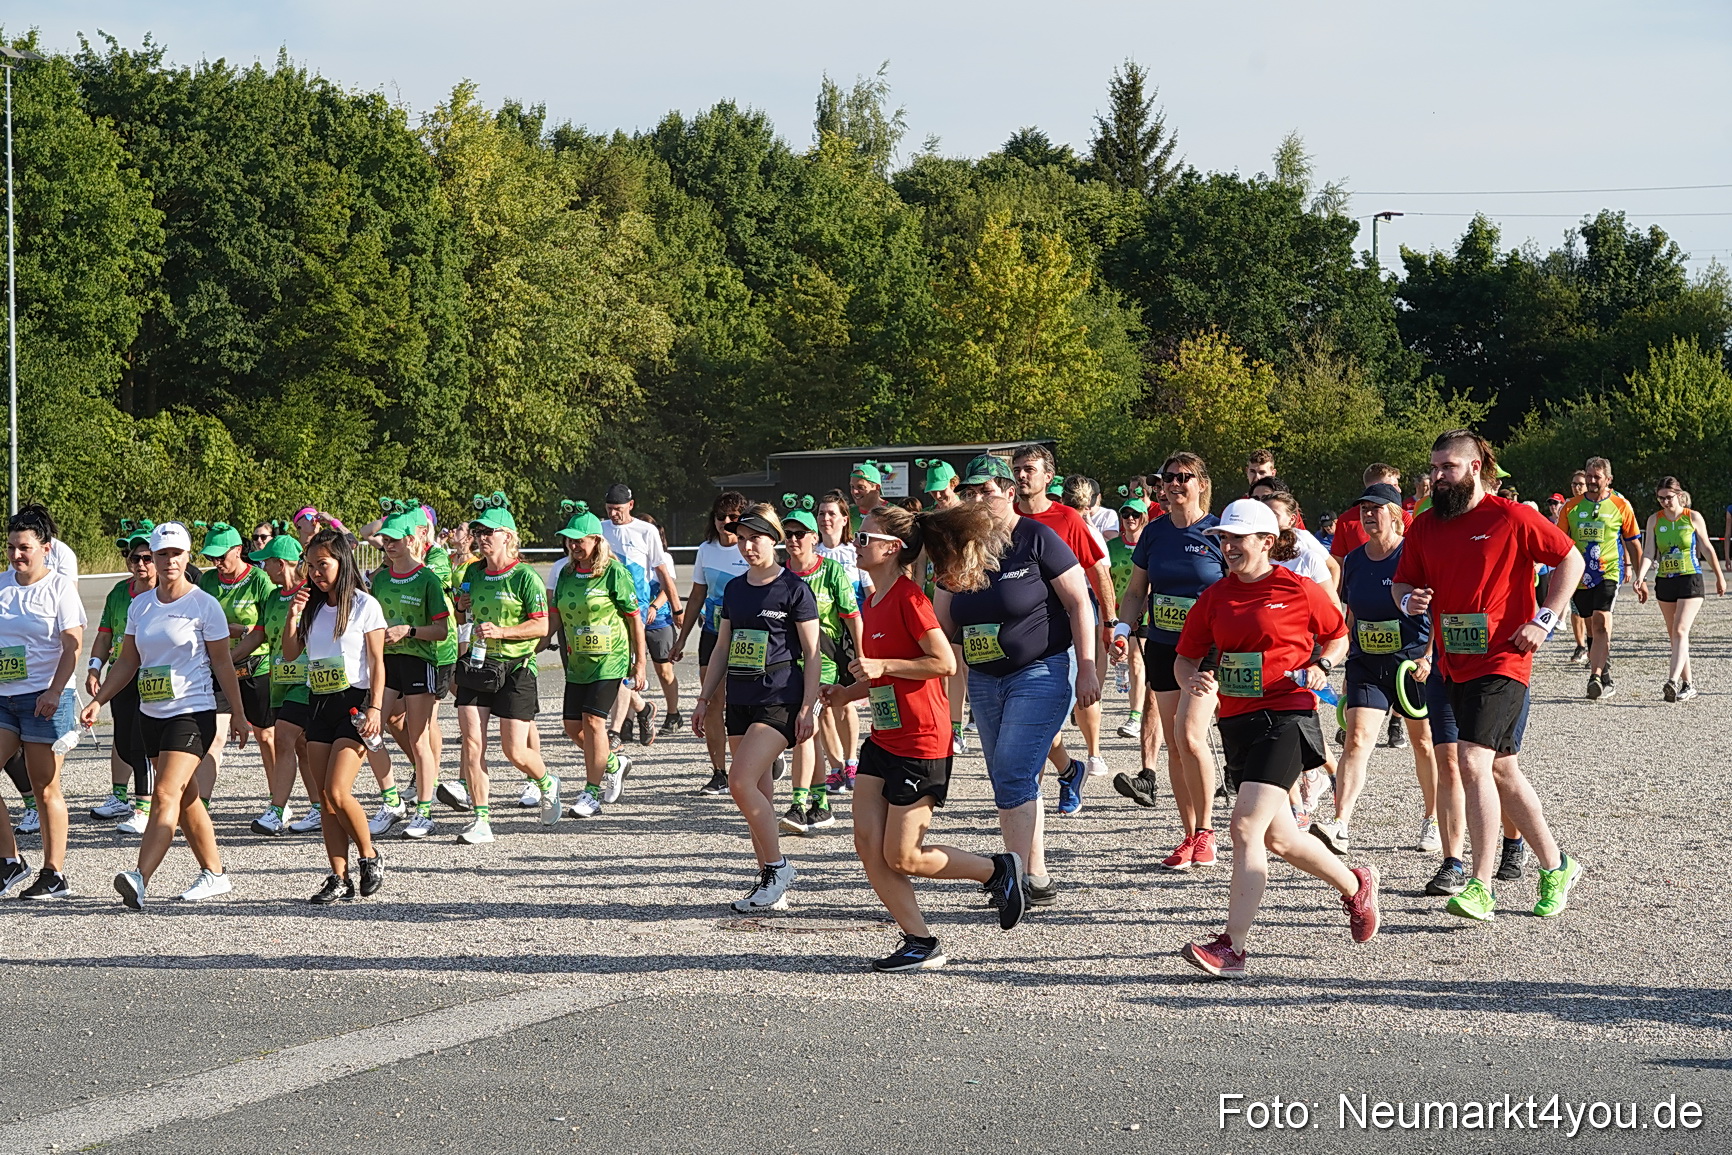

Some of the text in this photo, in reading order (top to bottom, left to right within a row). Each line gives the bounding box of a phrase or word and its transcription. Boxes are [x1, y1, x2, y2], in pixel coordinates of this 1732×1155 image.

[1583, 528, 1598, 536] 636
[1184, 543, 1200, 553] vhs
[1665, 559, 1679, 568] 616
[1158, 606, 1187, 621] 1426
[585, 635, 599, 645] 98
[1364, 632, 1394, 644] 1428
[1447, 628, 1479, 641] 1710
[734, 642, 755, 655] 885
[970, 637, 989, 652] 893
[283, 664, 297, 675] 92
[312, 668, 340, 684] 1876
[1221, 667, 1253, 683] 1713
[141, 677, 165, 692] 1877
[890, 702, 898, 723] 2022
